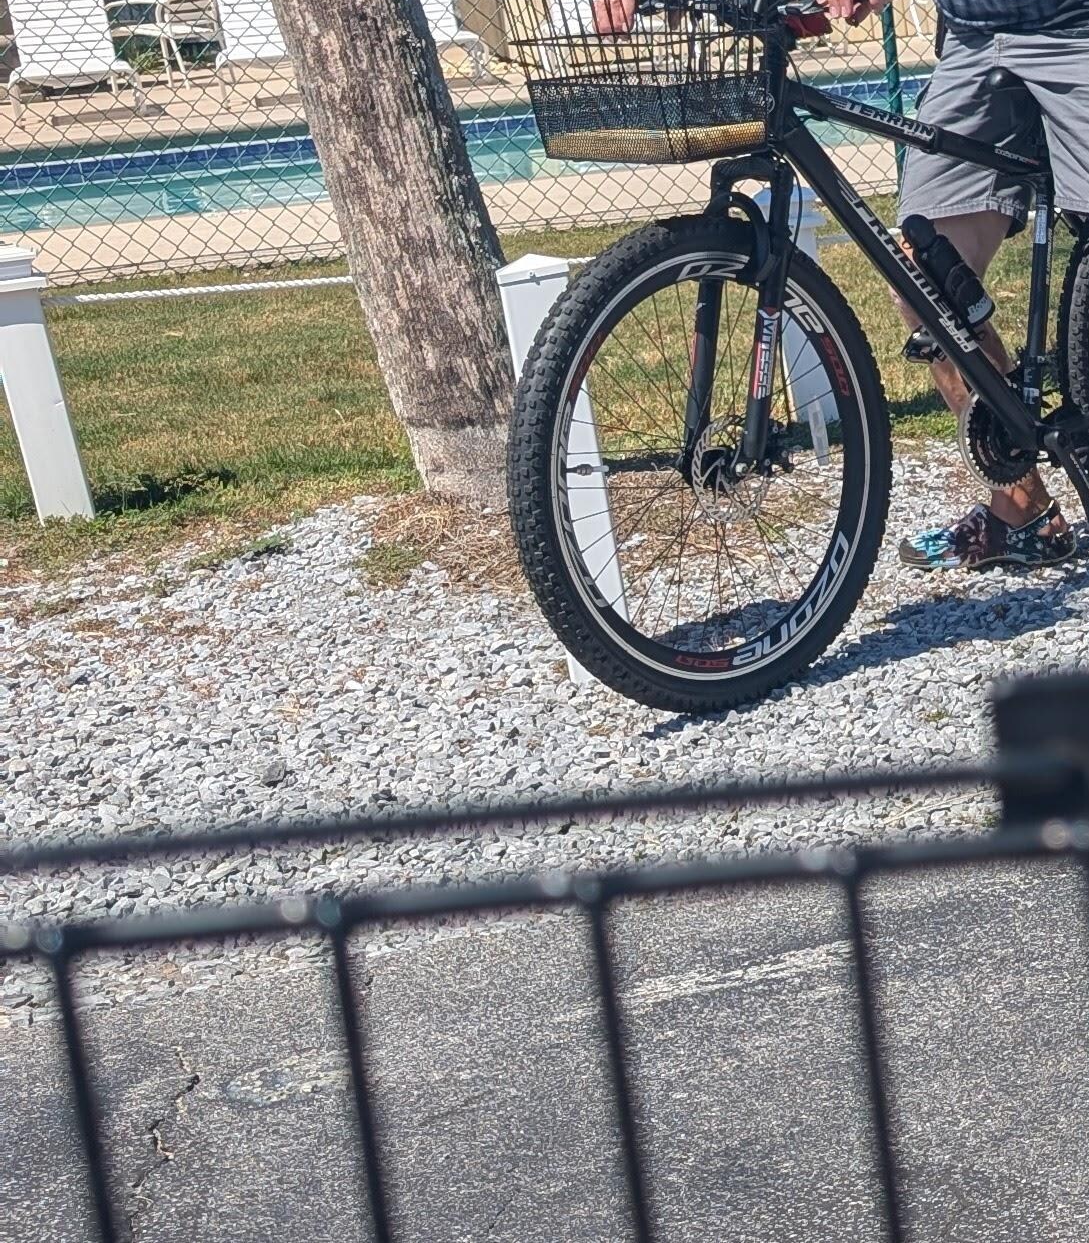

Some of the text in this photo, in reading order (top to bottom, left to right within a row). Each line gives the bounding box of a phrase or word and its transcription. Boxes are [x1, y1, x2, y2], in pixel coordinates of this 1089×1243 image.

[846, 98, 937, 141] TERRAIN
[938, 317, 972, 353] 2900
[756, 317, 778, 400] VITESSE
